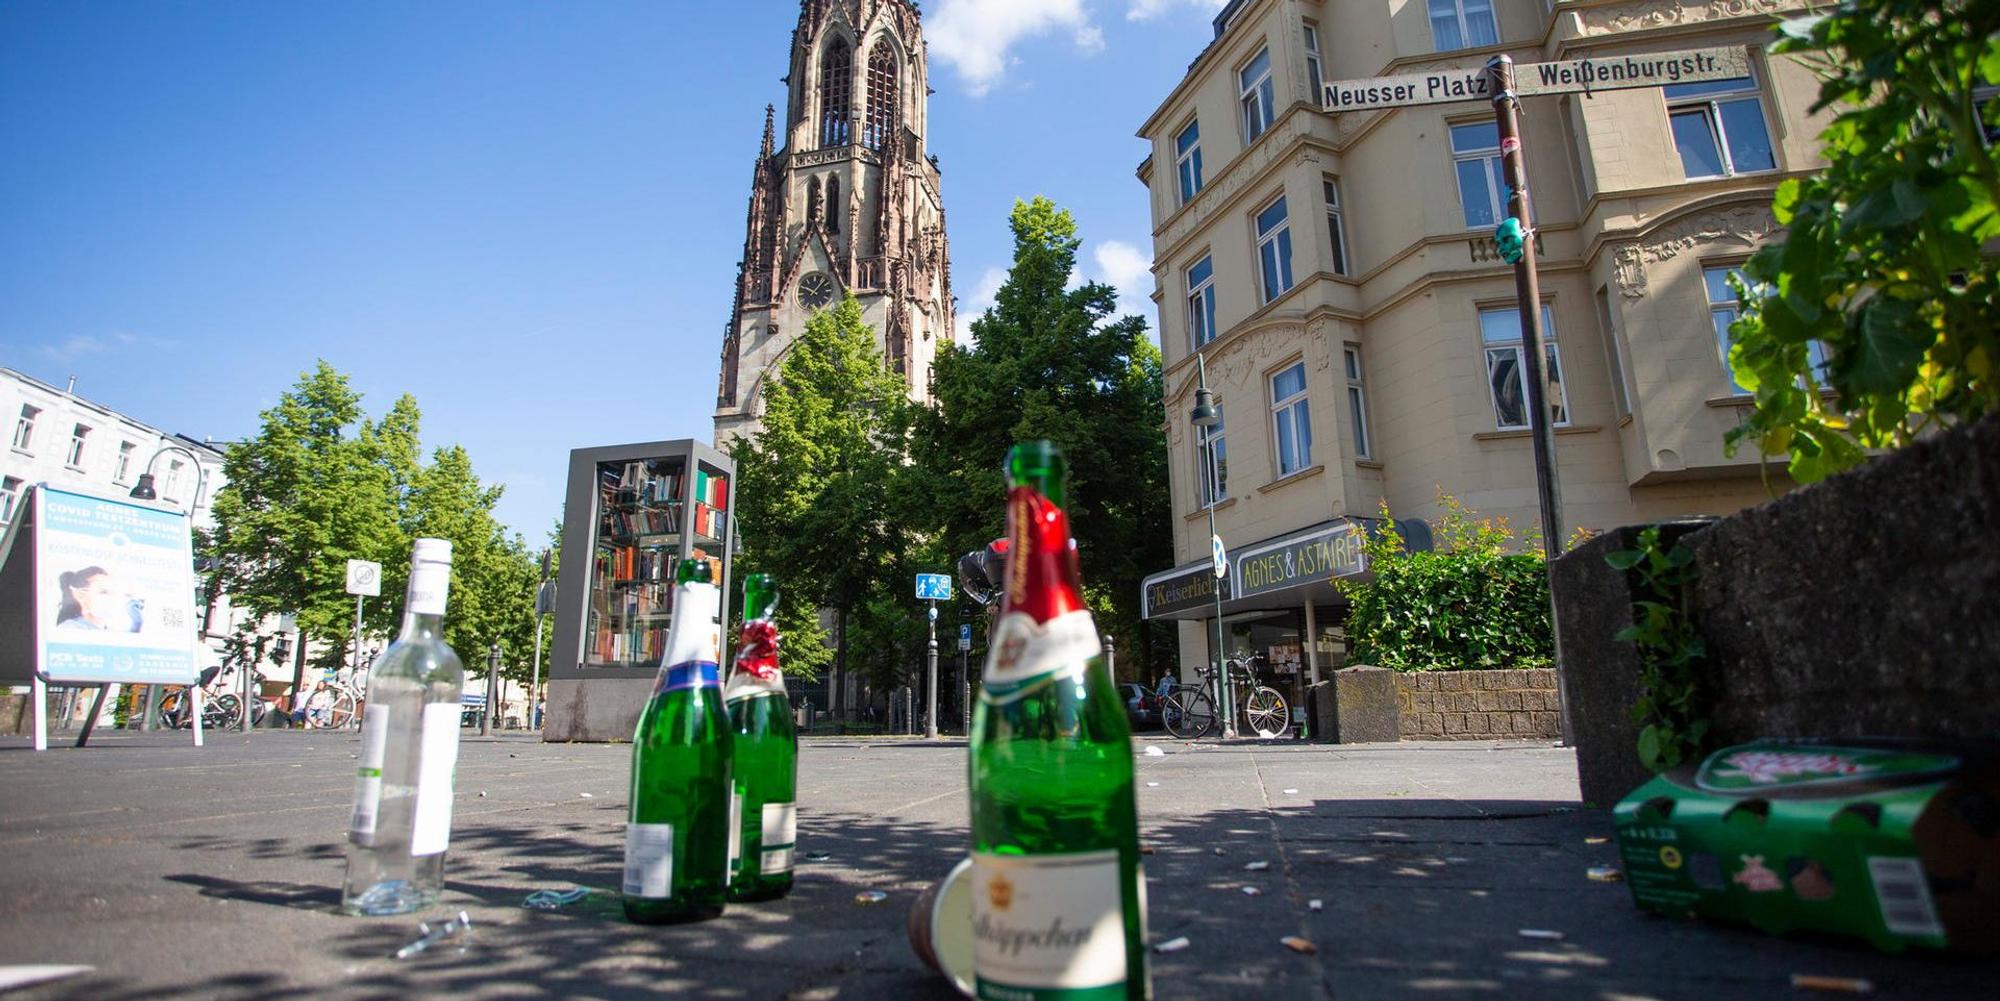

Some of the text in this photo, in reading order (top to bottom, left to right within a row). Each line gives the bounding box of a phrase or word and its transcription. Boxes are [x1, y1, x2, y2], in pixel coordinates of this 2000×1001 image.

[1538, 51, 1724, 88] Weißenburgstr.
[1324, 73, 1489, 107] Neusser Platz
[48, 502, 91, 517] COVID
[93, 510, 182, 533] TESTZENTRUM
[1244, 554, 1285, 589] AGNES
[1297, 535, 1357, 578] ASTAIRE
